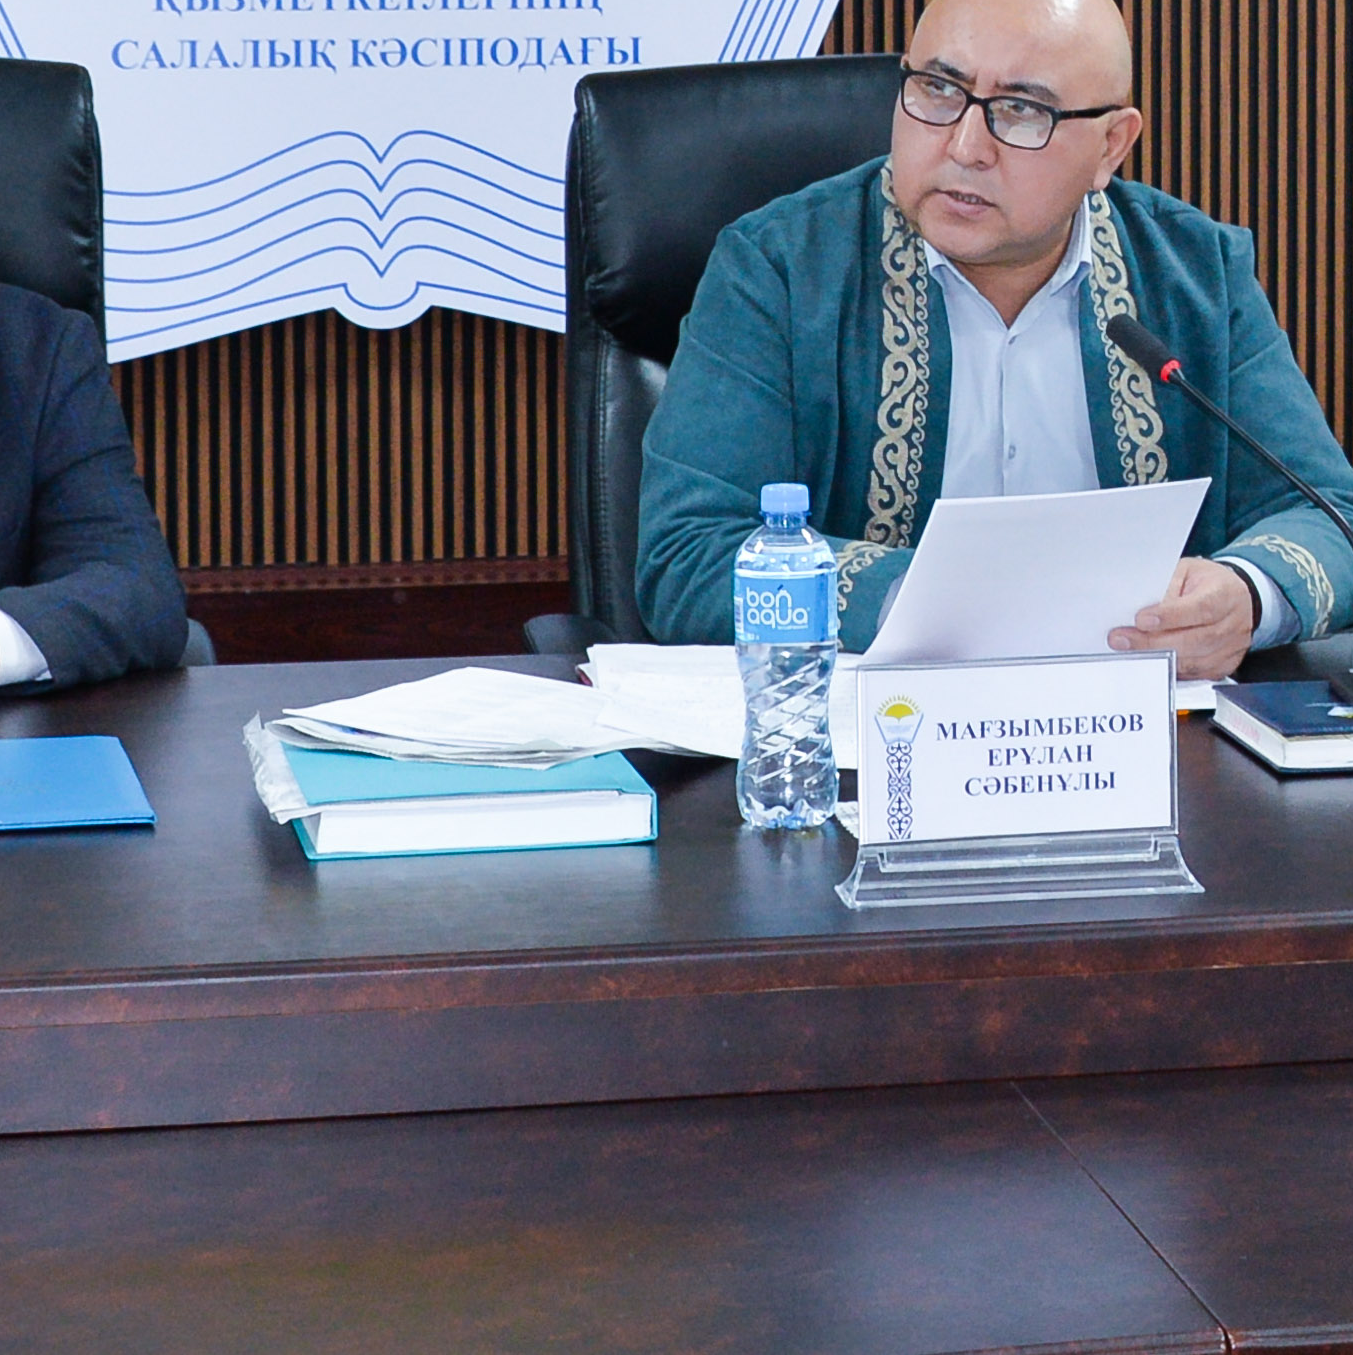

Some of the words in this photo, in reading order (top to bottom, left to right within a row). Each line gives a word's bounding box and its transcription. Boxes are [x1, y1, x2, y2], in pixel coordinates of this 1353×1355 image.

[110, 39, 338, 74] САЛАЛЫҚ
[350, 35, 643, 73] КӘСІПОДАҒЫ
[746, 586, 793, 609] bon
[746, 606, 809, 630] aqua
[935, 713, 1145, 742] МАҒЗЫМБЕКОВ
[987, 744, 1094, 767] ЕРҰЛАН
[964, 771, 1117, 797] СӘБЕНҰЛЫ
